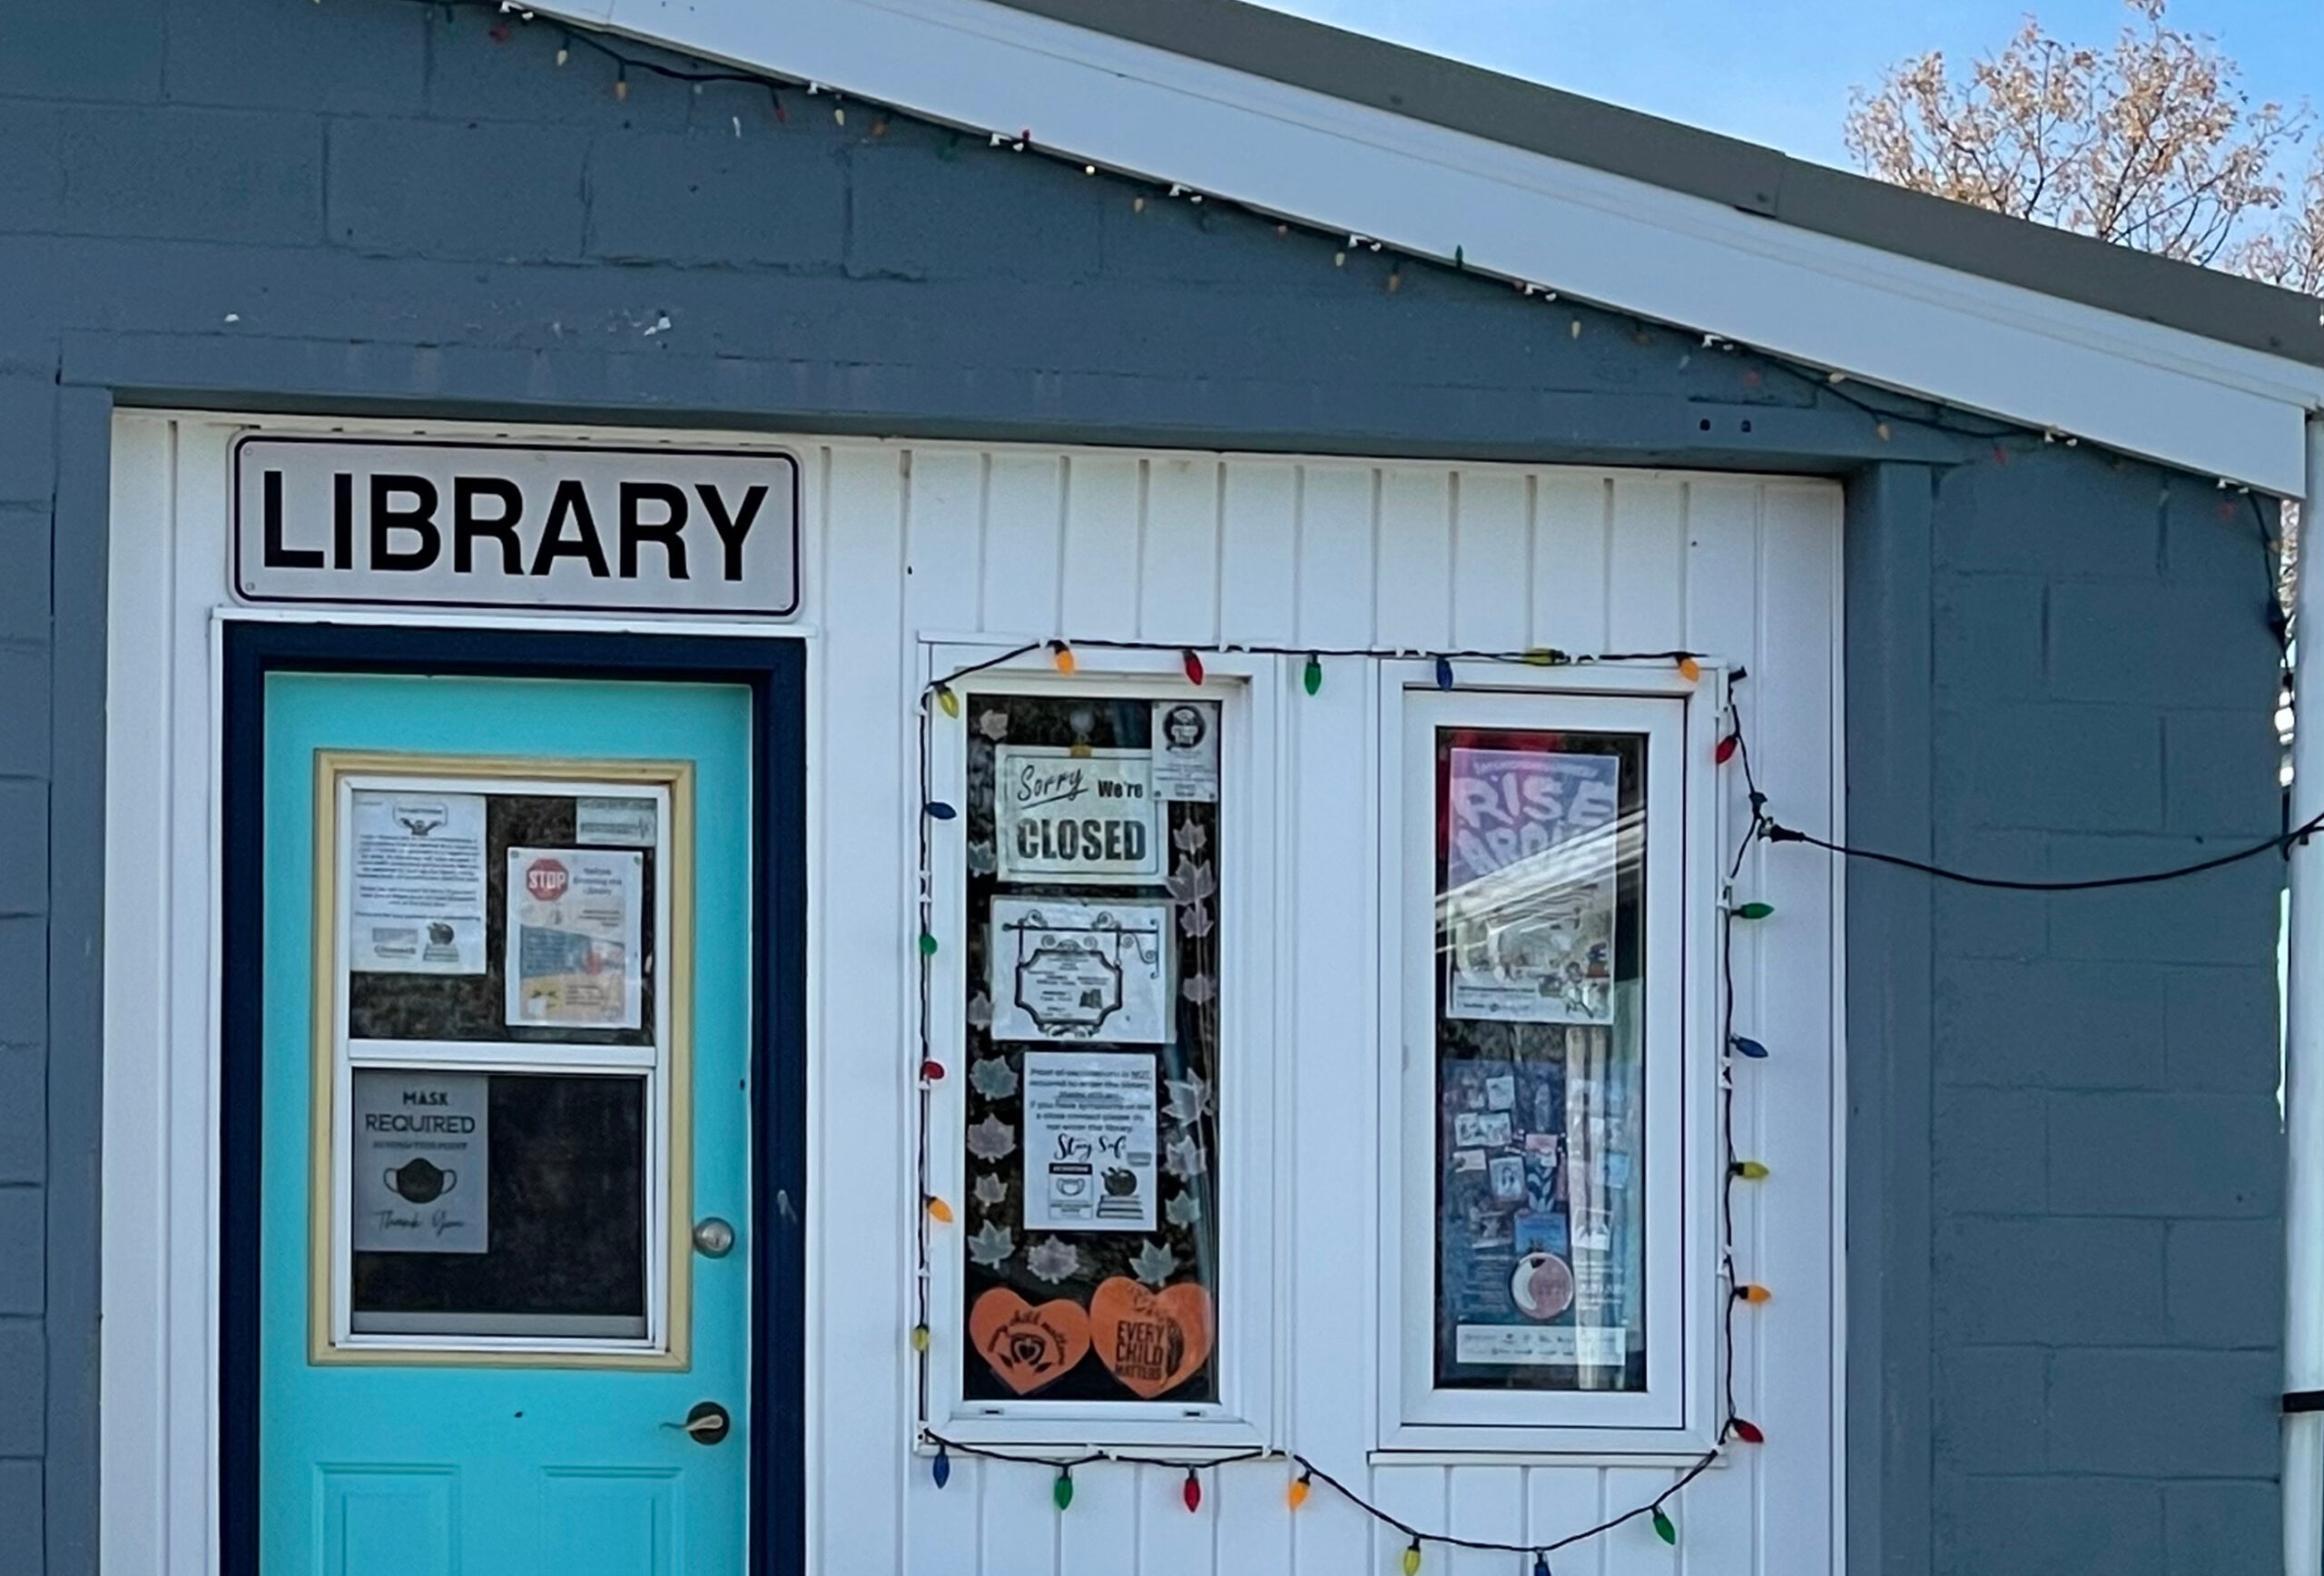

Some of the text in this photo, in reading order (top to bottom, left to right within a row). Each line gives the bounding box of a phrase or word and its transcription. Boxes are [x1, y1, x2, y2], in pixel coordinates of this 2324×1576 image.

[263, 470, 770, 581] LIBRARY
[1017, 763, 1085, 803] Sorry
[1098, 779, 1143, 799] We're
[1452, 773, 1616, 830] RISE
[1017, 818, 1147, 862] CLOSED
[528, 869, 567, 891] STOP
[403, 1091, 448, 1106] MASK
[365, 1114, 476, 1134] REQUIRED
[1054, 1133, 1092, 1163] Stay
[374, 1209, 421, 1231] Thank
[1118, 1320, 1165, 1344] EVERY
[1116, 1342, 1163, 1366] CHILD
